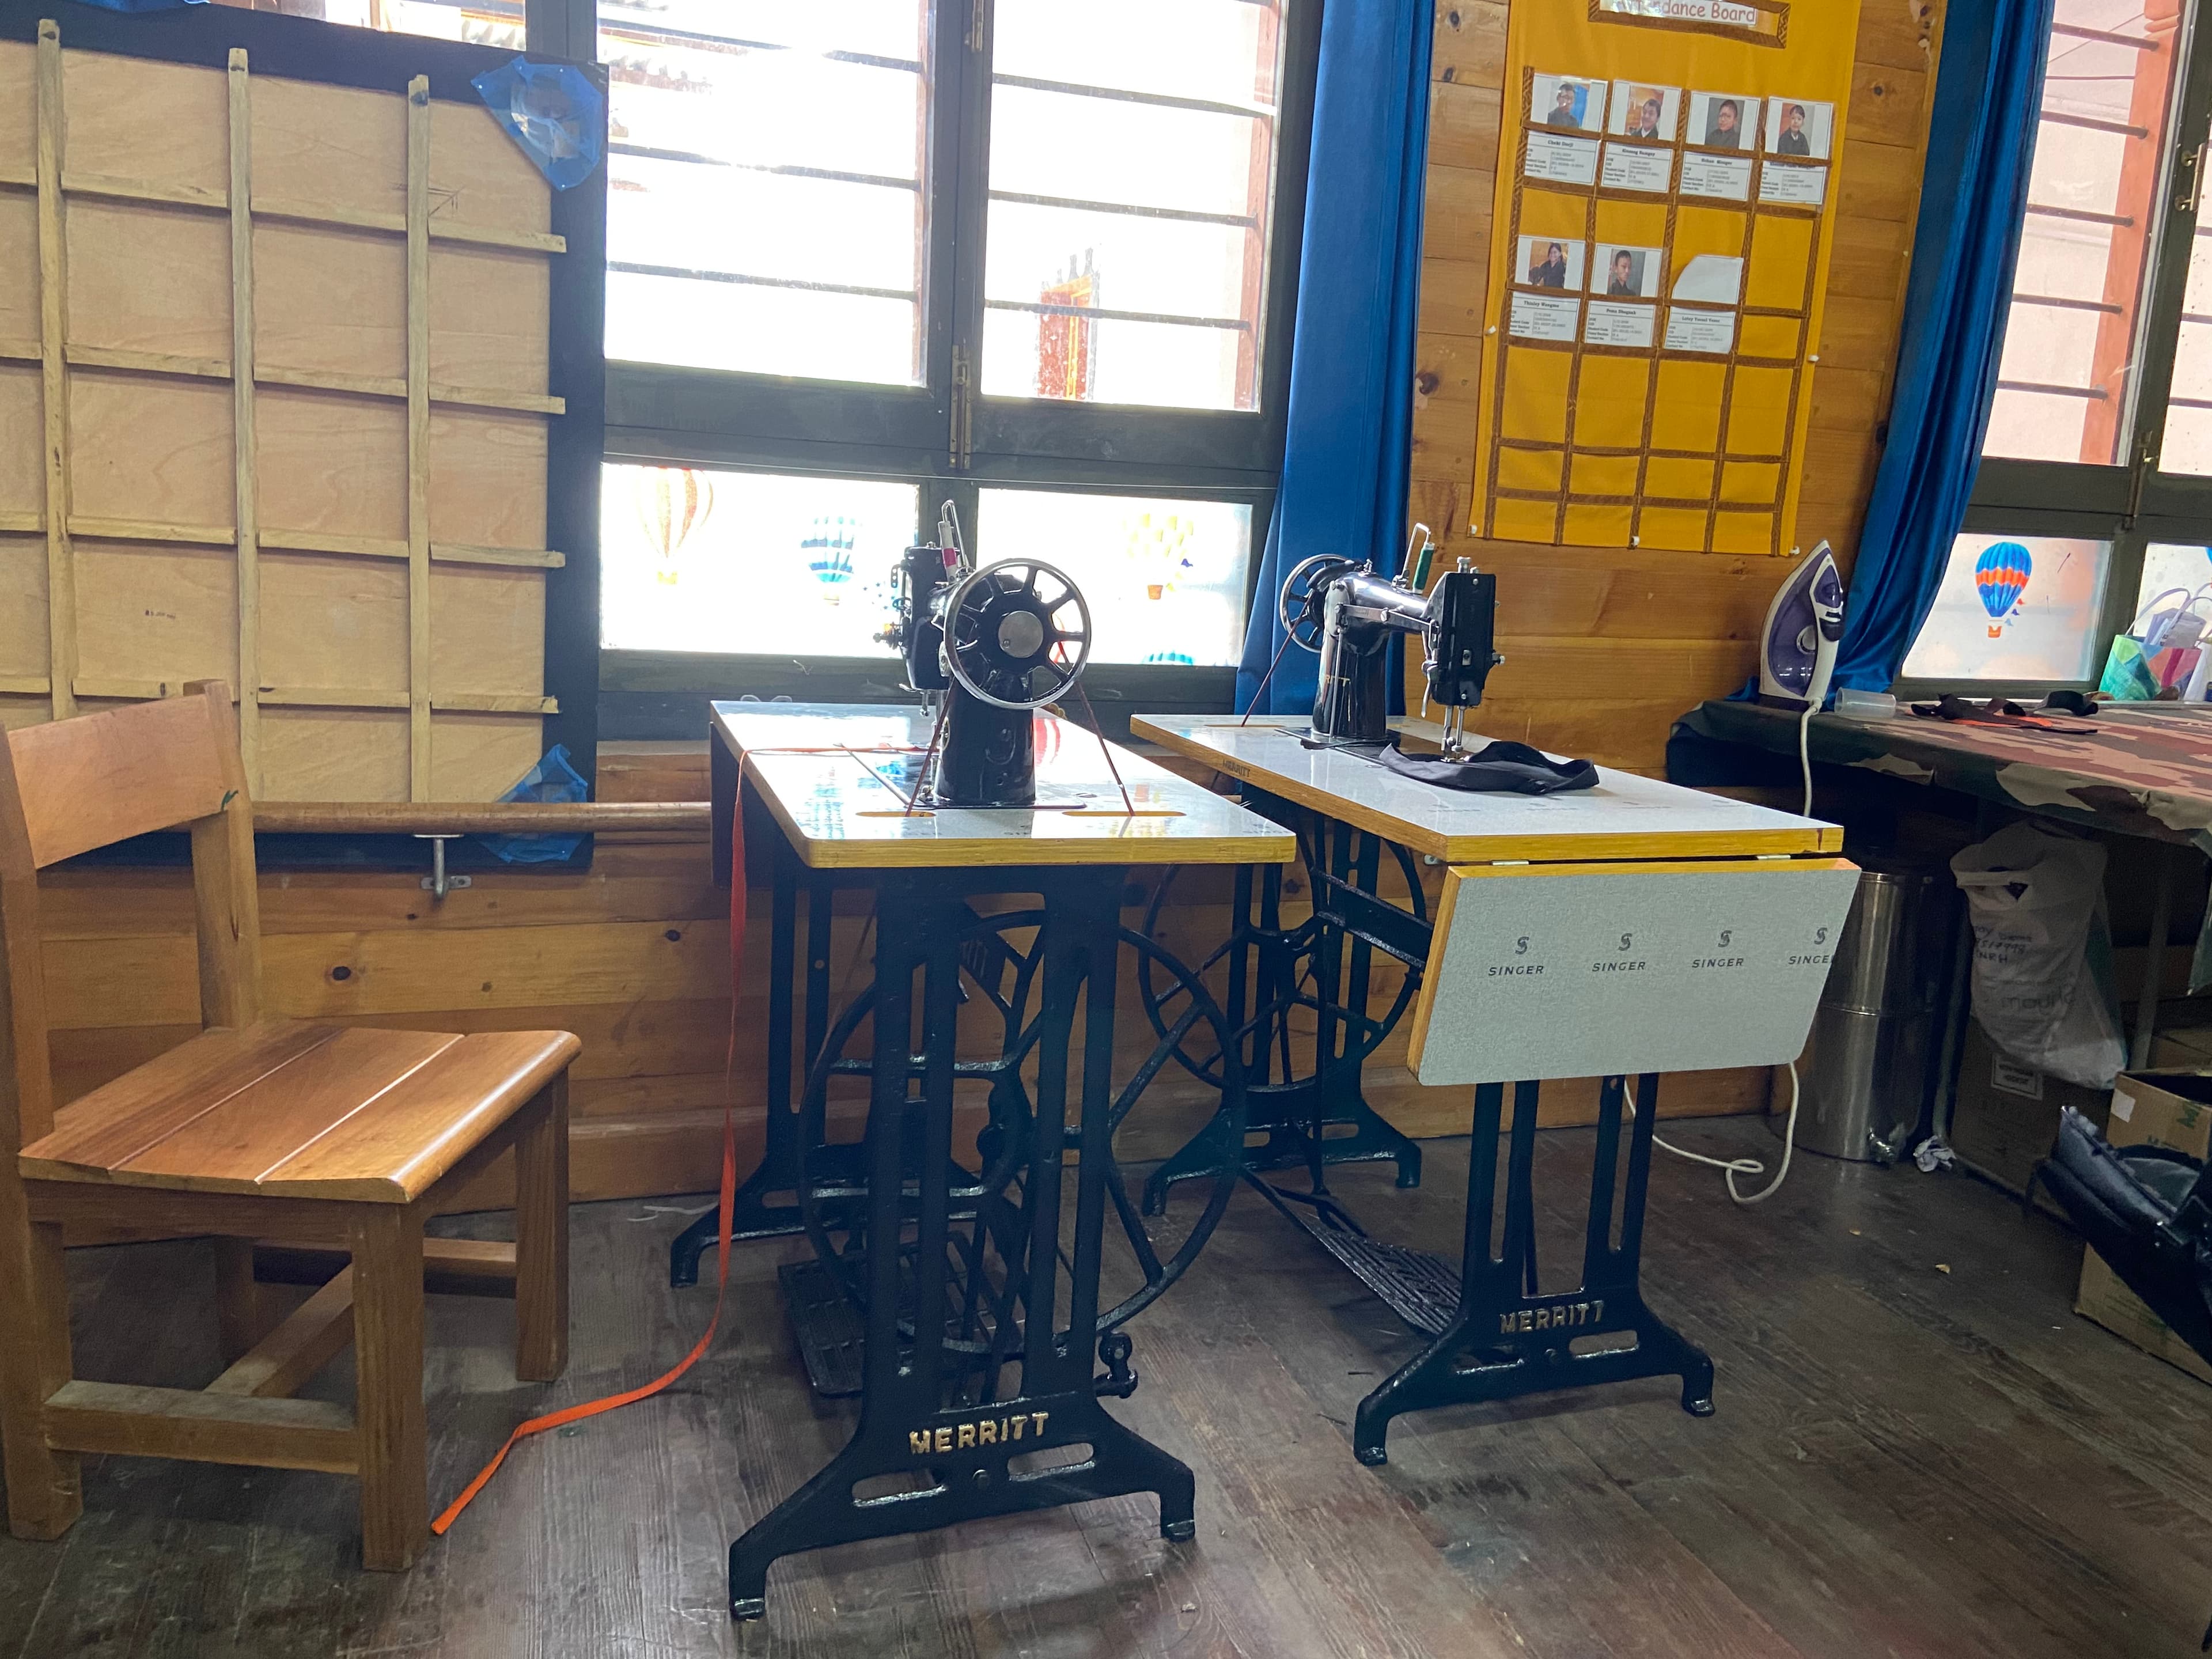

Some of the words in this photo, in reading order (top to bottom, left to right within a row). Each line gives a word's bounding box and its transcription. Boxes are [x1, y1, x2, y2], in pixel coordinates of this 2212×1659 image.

[1711, 2, 1756, 22] Board
[1692, 957, 1744, 968] SINGER
[1787, 955, 1834, 965] SINGE
[1488, 965, 1544, 976] SINGER
[1592, 961, 1646, 972] SINGER
[1499, 1300, 1604, 1334] MERRITT
[909, 1411, 1049, 1455] MERRITT
